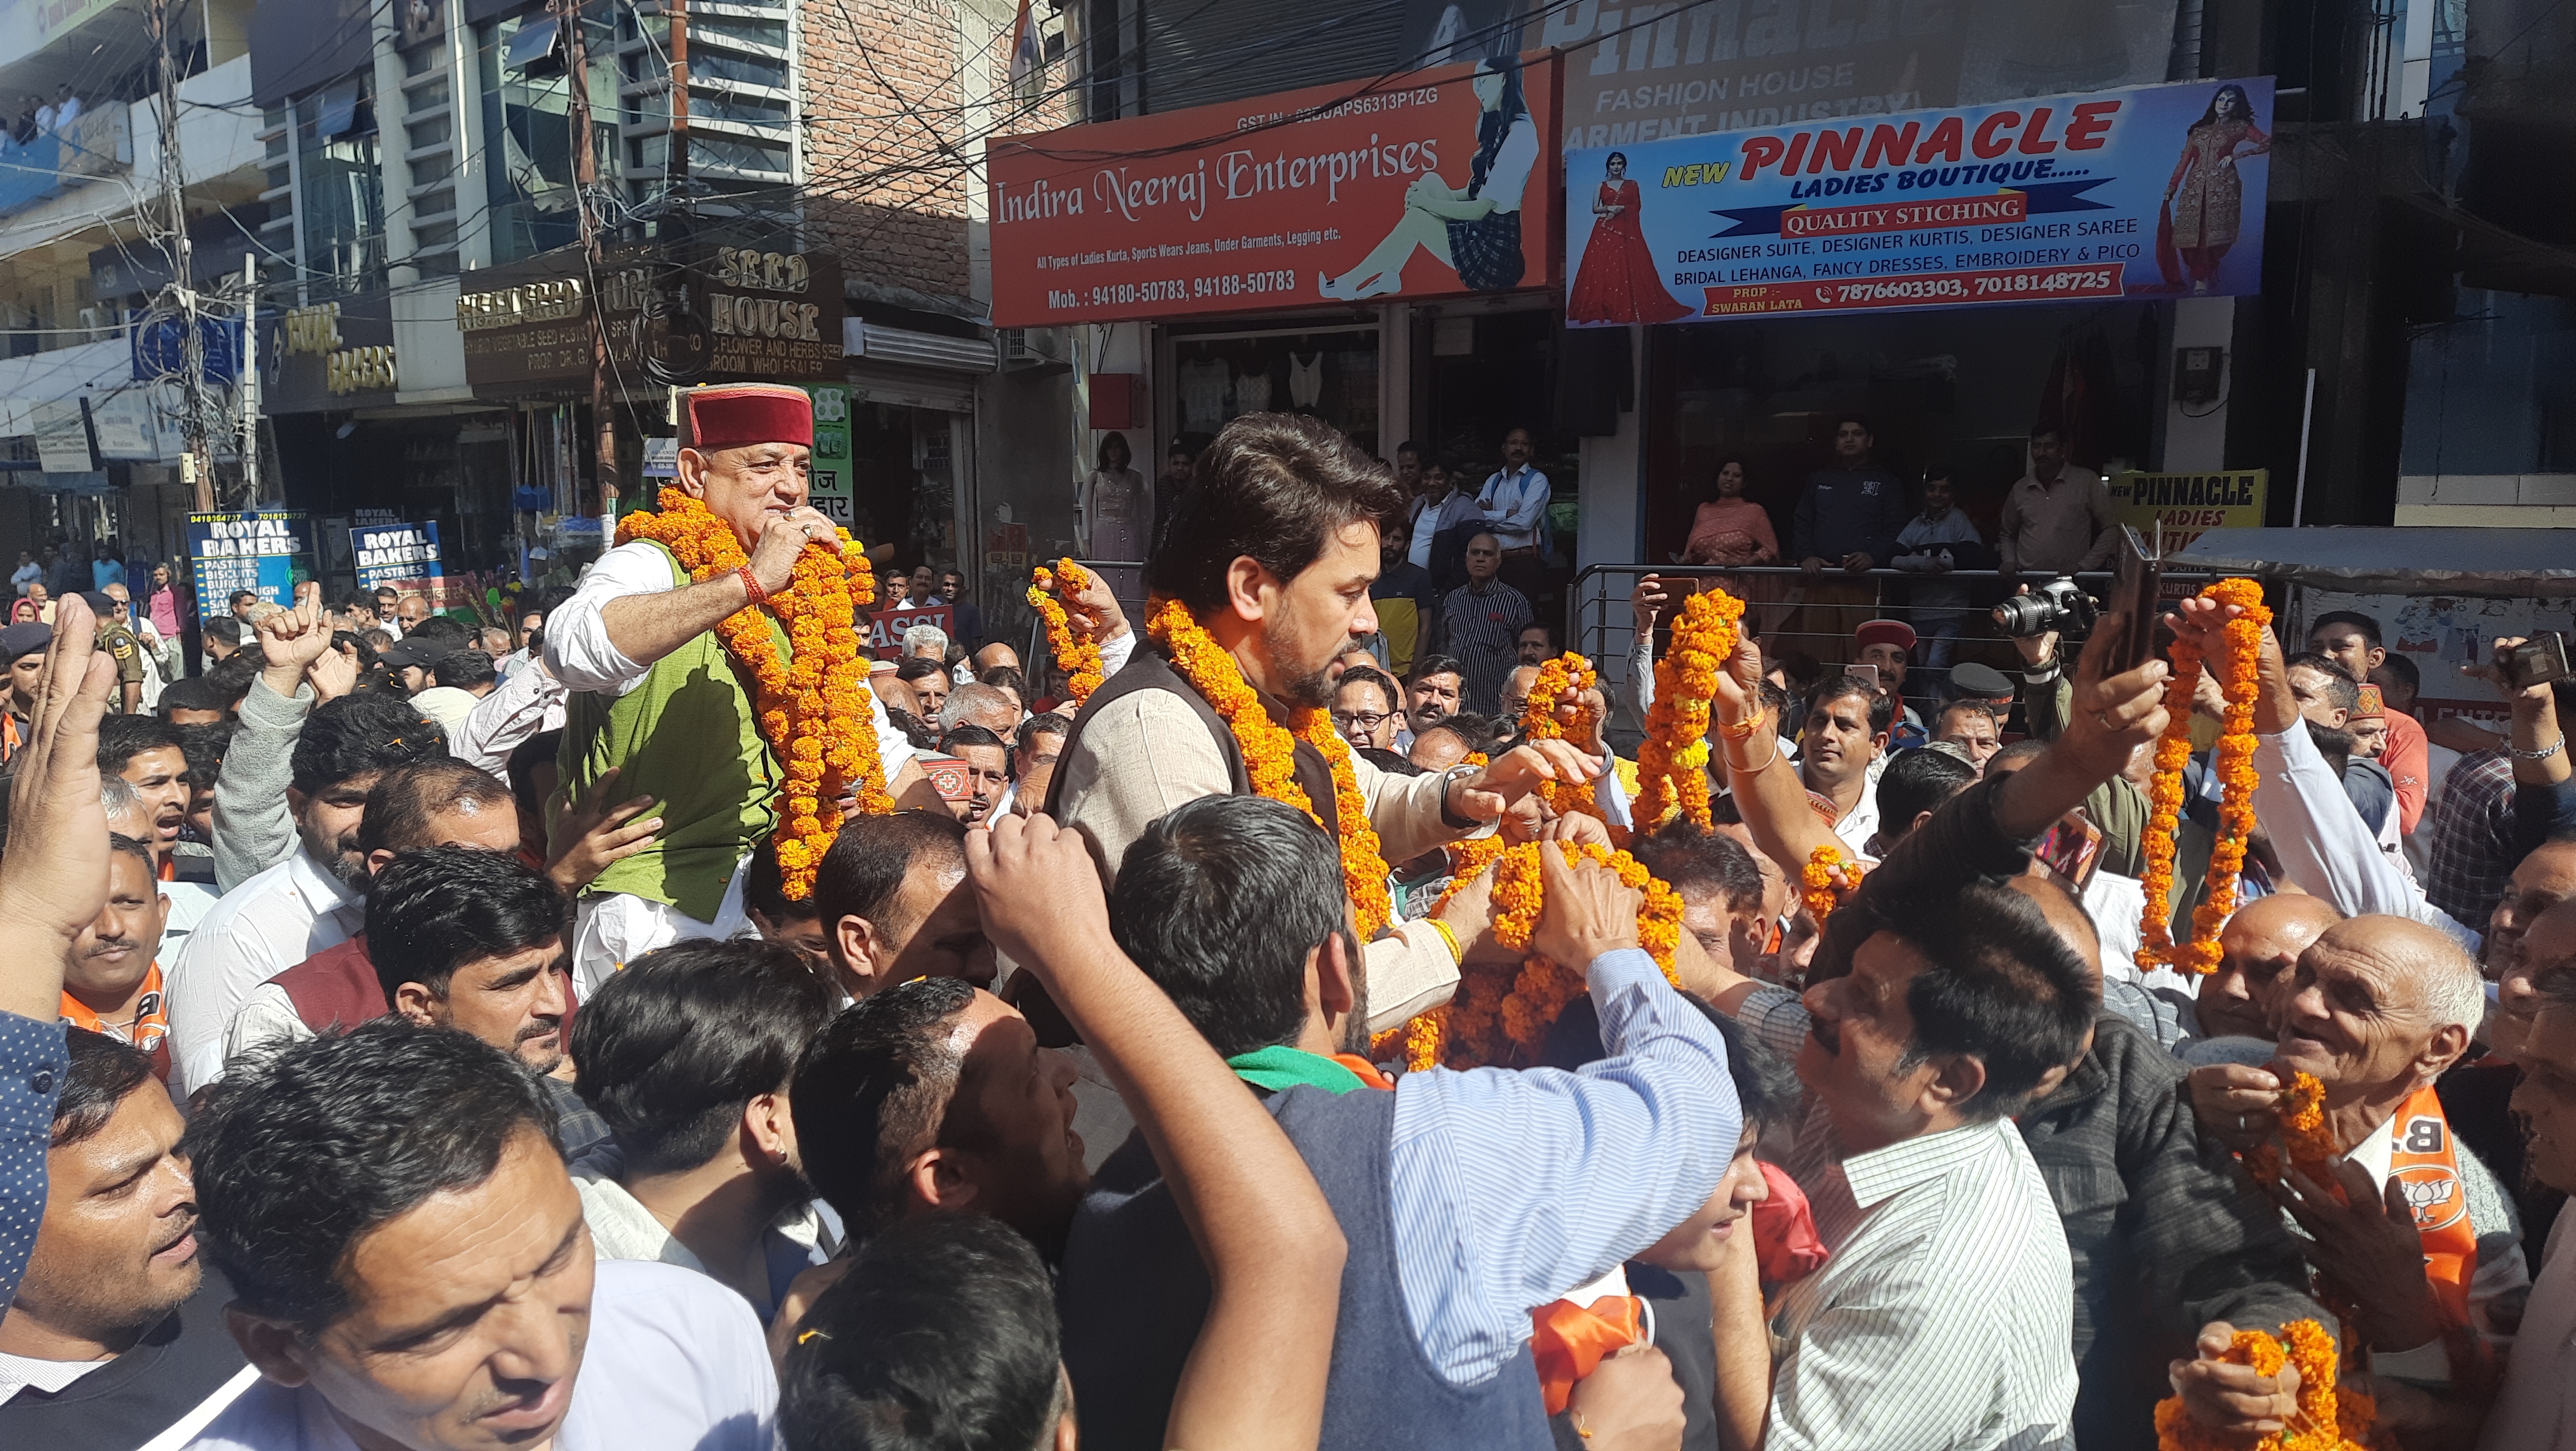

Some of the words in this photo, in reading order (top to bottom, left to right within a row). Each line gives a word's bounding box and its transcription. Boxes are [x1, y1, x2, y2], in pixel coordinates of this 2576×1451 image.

[1597, 77, 1729, 113] FASHION
[1739, 62, 1856, 98] HOUSE
[1237, 114, 1265, 133] GST
[1662, 162, 1731, 188] NEW
[1739, 100, 2121, 181] PINNACLE
[995, 179, 1085, 224] Indira
[1093, 159, 1206, 222] Neeraj
[1216, 133, 1438, 206] Enterprises
[1790, 173, 1889, 199] LADIES
[1787, 208, 1890, 236] QUALITY
[1896, 198, 2021, 225] STICHING
[1037, 256, 1047, 269] All
[1048, 255, 1069, 270] Types
[1071, 253, 1079, 266] of
[1080, 251, 1105, 265] Ladies
[1106, 249, 1130, 262] Kurta,
[1131, 246, 1157, 262] Sports
[1158, 244, 1184, 257] Wears
[1185, 241, 1212, 255] Jeans,
[1214, 238, 1239, 252] Under
[1241, 233, 1285, 250] Garments,
[1287, 228, 1321, 246] Legging
[1324, 227, 1341, 241] etc.
[1678, 245, 1761, 263] DEASIGNER
[1767, 241, 1815, 257] SUITE,
[1822, 235, 1903, 253] DESIGNER
[1910, 230, 1974, 246] KURTIS,
[1982, 223, 2071, 242] DESIGNER
[2077, 218, 2138, 236] SAREE
[718, 246, 809, 294] SEED
[1675, 271, 1726, 285] BRIDAL
[1731, 265, 1807, 283] LEHANGA,
[1813, 261, 1863, 276] FANCY
[1870, 256, 1948, 273] DRESSES,
[1956, 247, 2071, 268] EMBROIDERY
[2077, 247, 2090, 261] &
[2098, 244, 2140, 260] PICO
[1048, 289, 1080, 309] Mob.
[1092, 279, 1189, 306] 94180-50783,
[1194, 269, 1295, 298] 94188-50783
[1733, 288, 1768, 298] PROP
[1837, 281, 1968, 303] 7876603303,
[1974, 271, 2111, 296] 7018148725
[709, 293, 821, 342] HOUSE
[1712, 301, 1765, 314] SWARAN
[1770, 299, 1803, 310] LATA
[538, 329, 558, 347] SEED
[721, 337, 763, 355] FLOWER
[766, 339, 786, 357] AND
[789, 342, 820, 359] HERBS
[2110, 485, 2132, 497] NEW
[2133, 476, 2255, 505] PINNACLE
[210, 519, 290, 539] ROYAL
[2154, 509, 2227, 527] LADIES
[202, 537, 301, 557] BAKERS
[363, 529, 427, 549] ROYAL
[204, 558, 260, 569] PASTRIES
[358, 544, 438, 567] BAKERS
[206, 568, 258, 580] BISCUITS
[207, 578, 257, 589] BURGUR
[368, 564, 424, 580] PASTRIES
[2159, 582, 2197, 596] KURTIS
